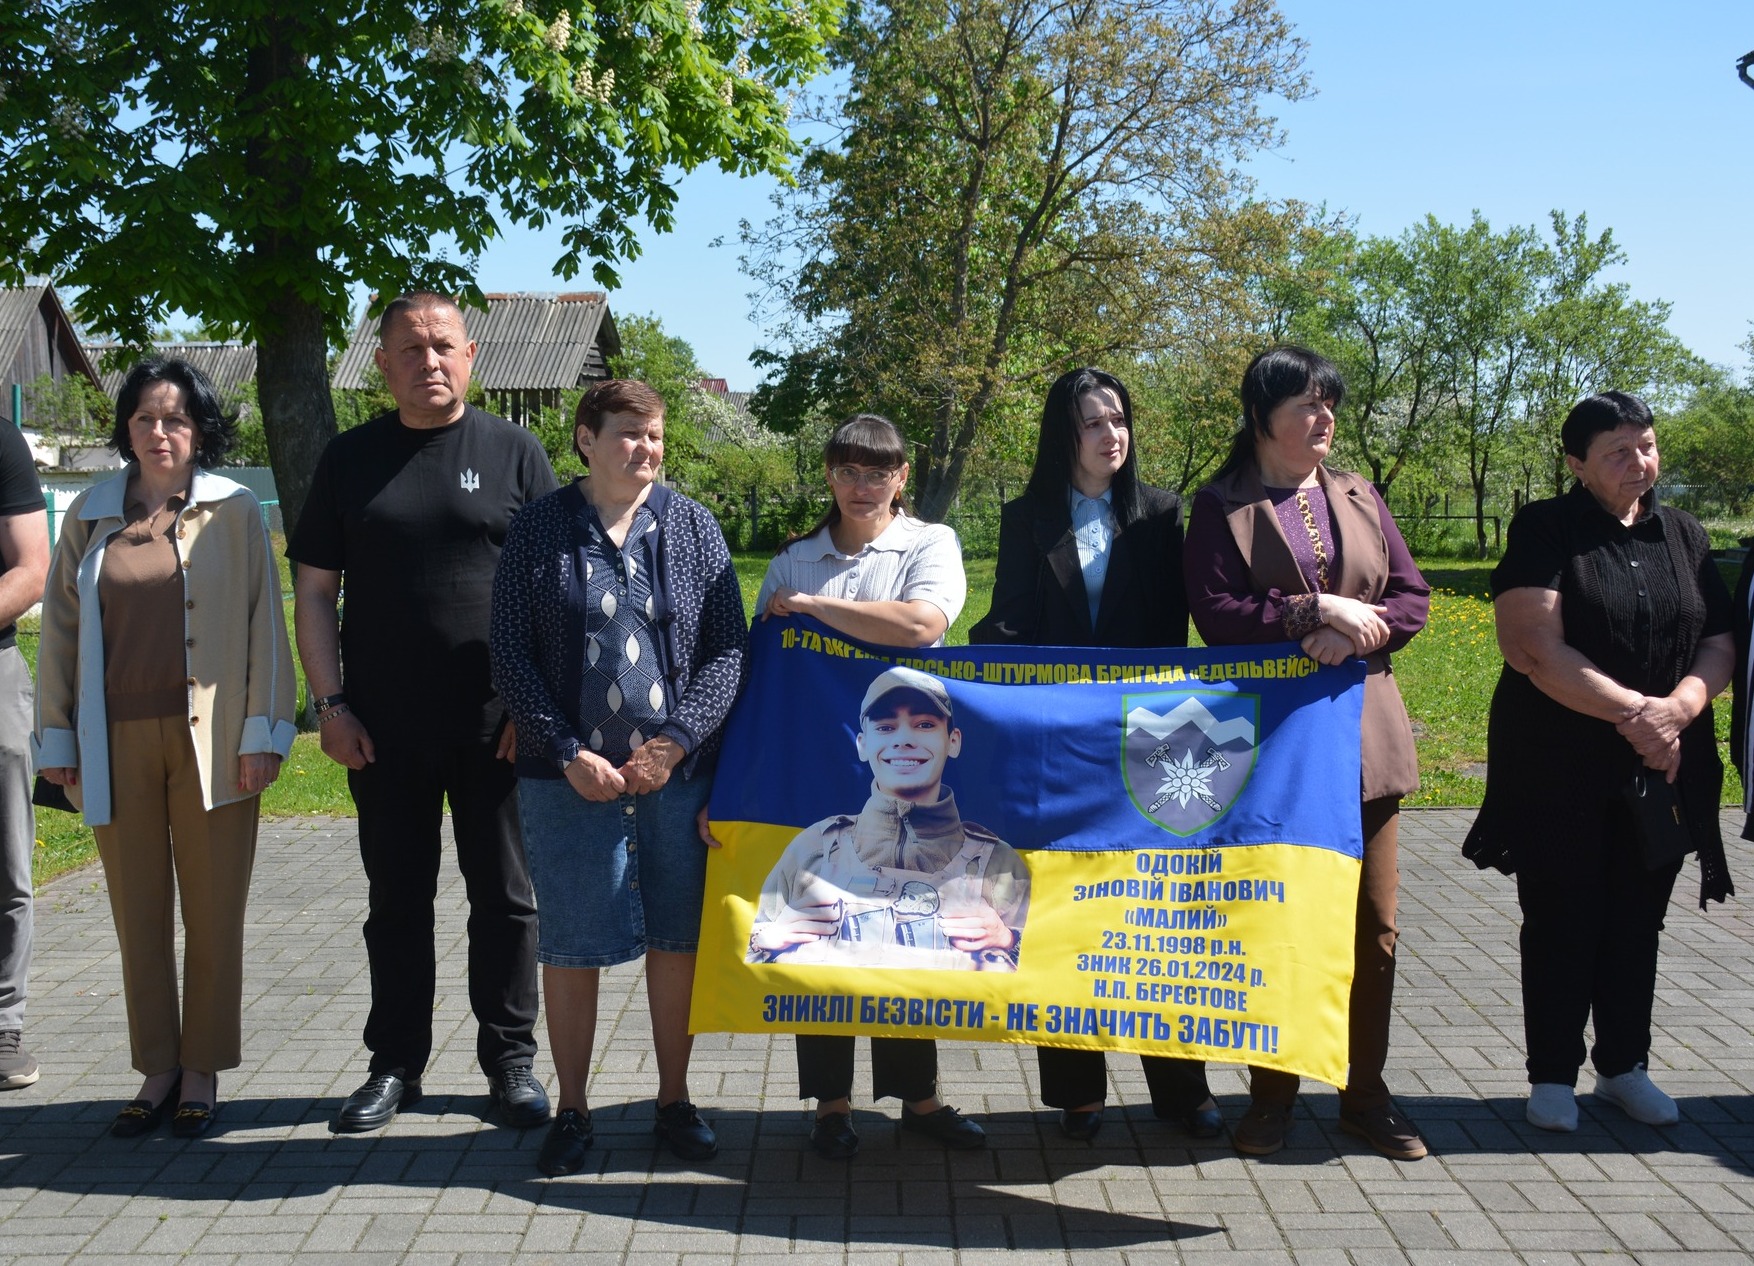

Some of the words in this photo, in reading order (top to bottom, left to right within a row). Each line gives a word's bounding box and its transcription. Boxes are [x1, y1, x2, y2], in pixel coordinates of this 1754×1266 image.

[781, 627, 821, 652] 10-ТА
[822, 637, 890, 662] ОКРЕ
[1097, 664, 1186, 685] БРИГАДА
[1190, 654, 1319, 681] «ЕДЕЛЬВЕЙС»
[1136, 850, 1222, 876] ОДОКІЙ
[1073, 876, 1164, 902] ЗІНОВІЙ
[1169, 879, 1285, 903] ІВАНОВИЧ
[1124, 905, 1228, 930] «МАЛИЙ»
[1102, 931, 1205, 955] 23.11.1998
[1210, 940, 1246, 957] р.н.
[1076, 954, 1132, 975] ЗНИК
[1136, 958, 1246, 983] 26.01.2024
[1250, 967, 1267, 988] р.
[1093, 979, 1131, 1000] Н.П.
[1136, 983, 1247, 1012] БЕРЕСТОВЕ
[762, 995, 853, 1024] ЗНИКЛІ
[859, 996, 985, 1029] БЕЗВІСТИ
[1006, 1003, 1039, 1032] НЕ
[1045, 1006, 1171, 1040] ЗНАЧИТЬ
[1177, 1016, 1279, 1054] ЗАБУТІ!
